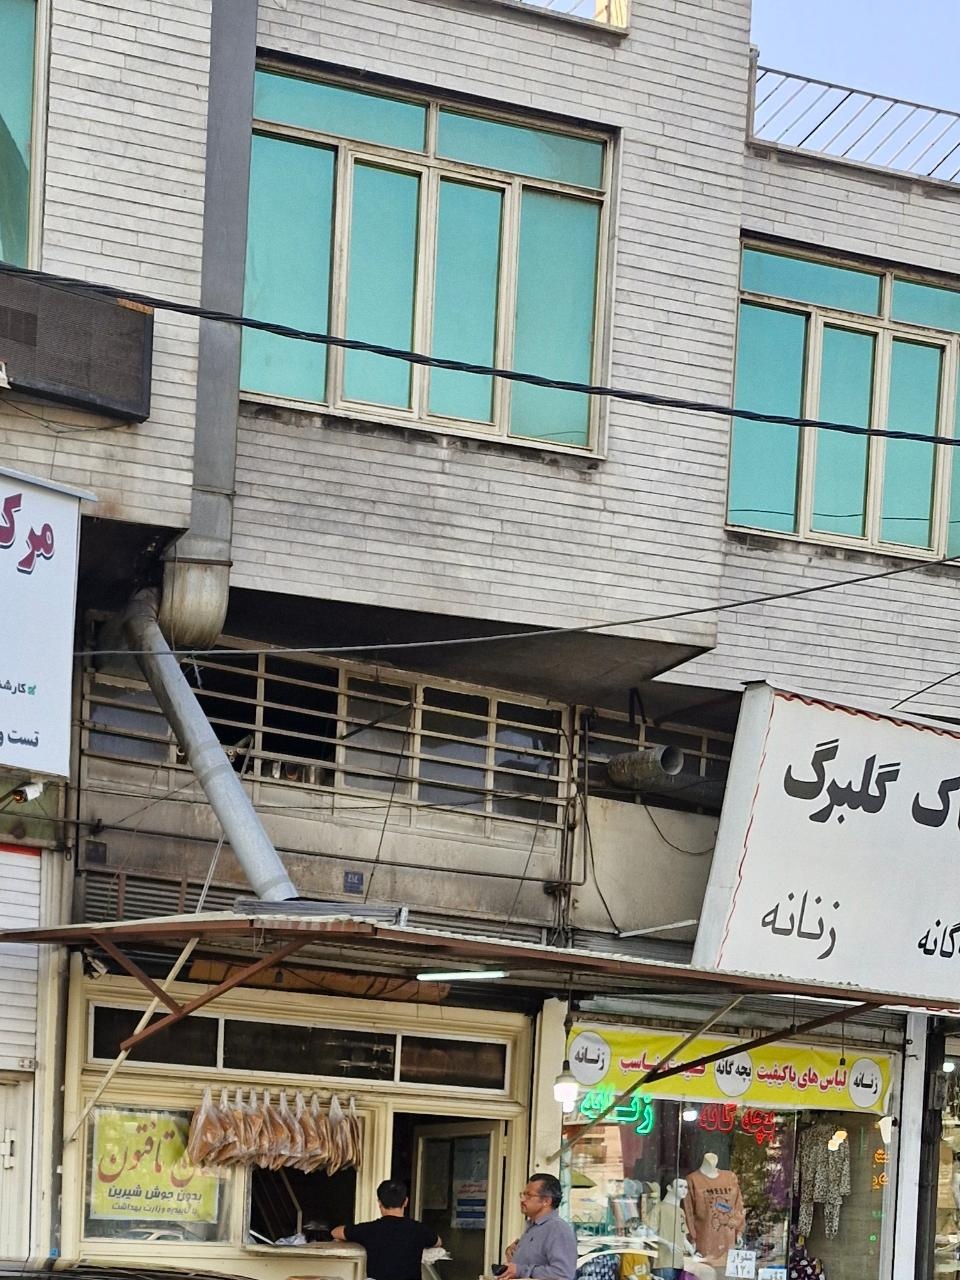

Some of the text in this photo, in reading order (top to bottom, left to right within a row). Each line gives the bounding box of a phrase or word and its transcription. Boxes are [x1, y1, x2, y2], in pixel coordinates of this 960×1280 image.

[7, 728, 39, 748] تست
[783, 737, 901, 824] گلبرگ
[761, 888, 841, 960] زنانه
[574, 1045, 605, 1071] زنانه
[716, 1058, 734, 1076] گانه
[735, 1063, 752, 1083] بچه
[797, 1065, 819, 1090] های
[820, 1067, 847, 1092] لباس
[853, 1071, 879, 1095] زنانه
[581, 1085, 655, 1134] زنانه
[699, 1103, 777, 1145] بچه گانه
[97, 1121, 176, 1184] تافتون
[107, 1184, 202, 1204] بدون جوش شیرین
[112, 1202, 142, 1212] بهداشت
